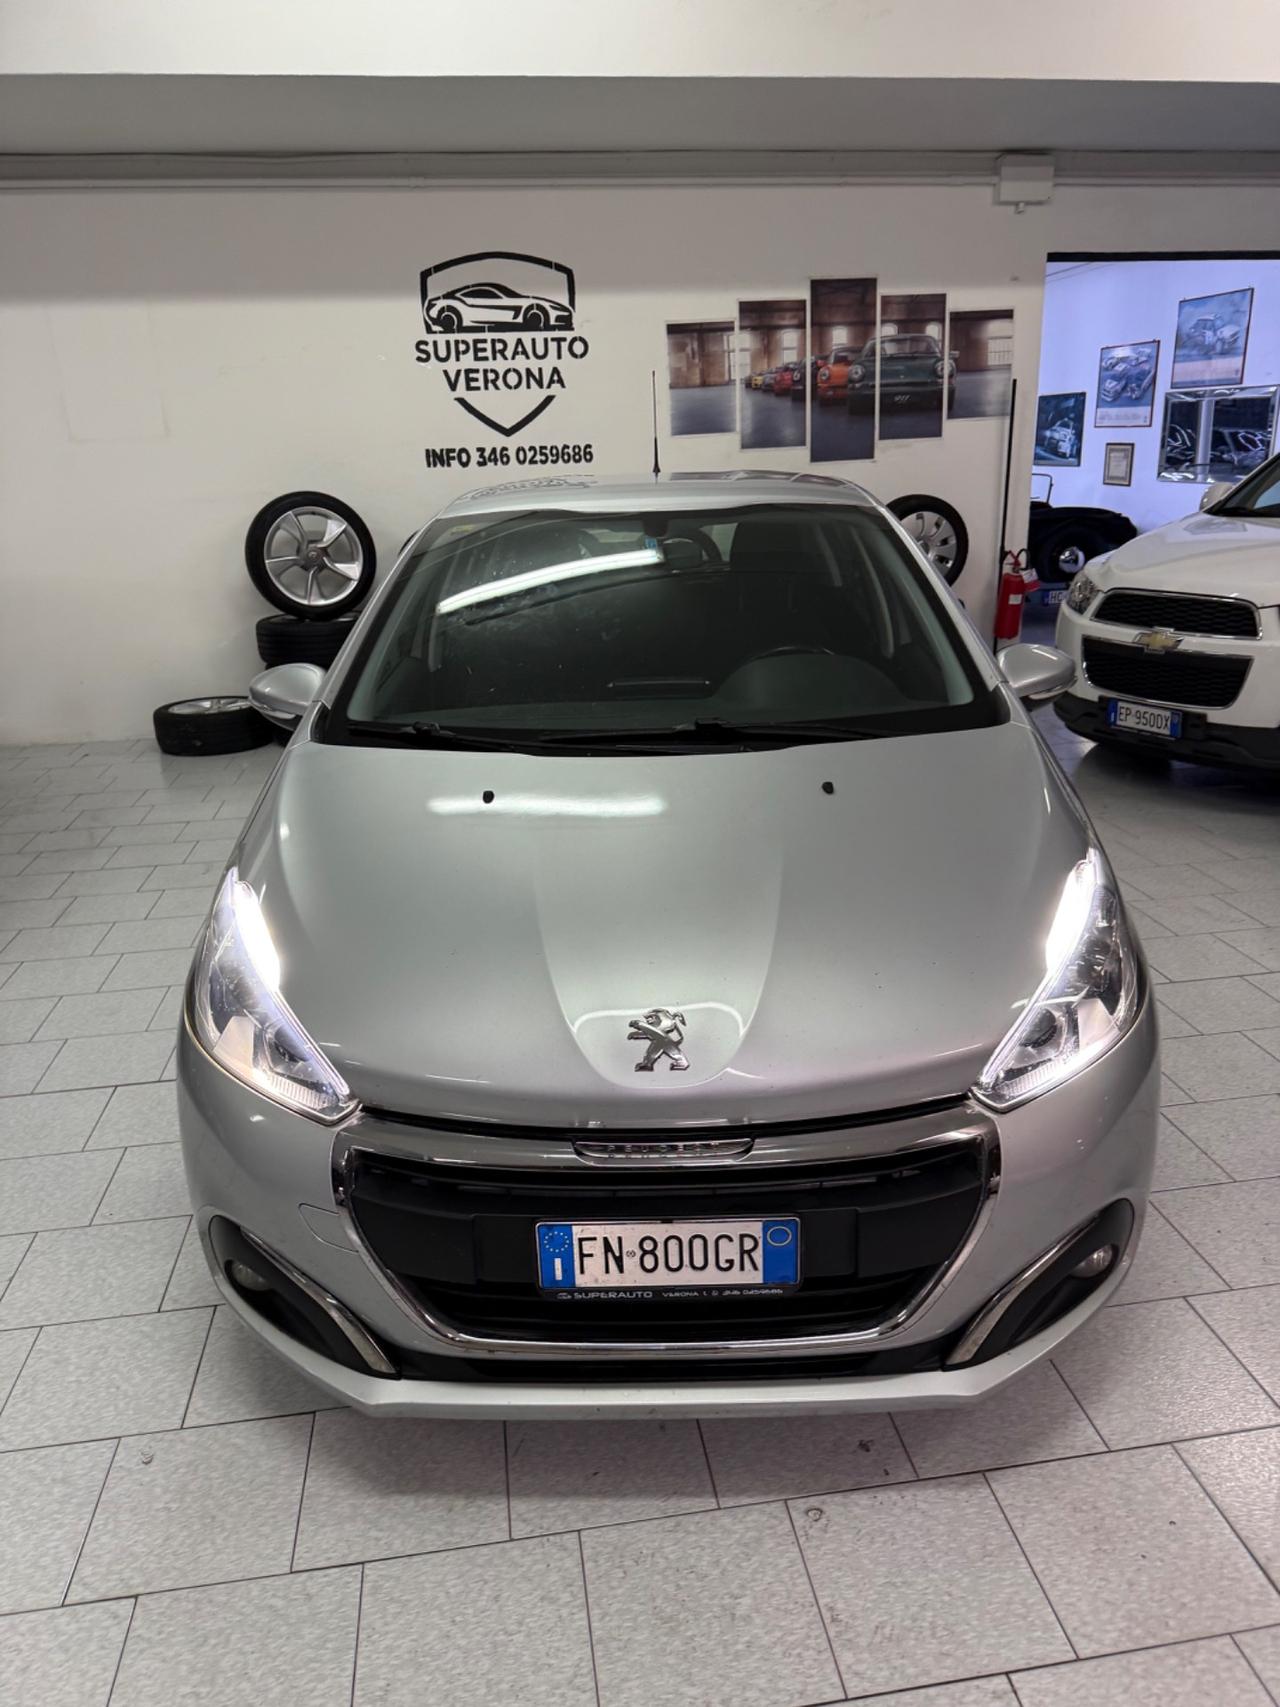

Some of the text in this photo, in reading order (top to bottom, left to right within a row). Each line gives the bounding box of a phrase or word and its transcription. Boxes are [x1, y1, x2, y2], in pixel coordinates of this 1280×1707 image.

[415, 336, 589, 363] SUPERAUTO
[443, 367, 566, 392] VERONA
[425, 444, 594, 468] INFO 346 0259686
[578, 1236, 625, 1275] FN
[638, 1233, 760, 1273] 800GR
[574, 1291, 653, 1299] SUPERAUTO
